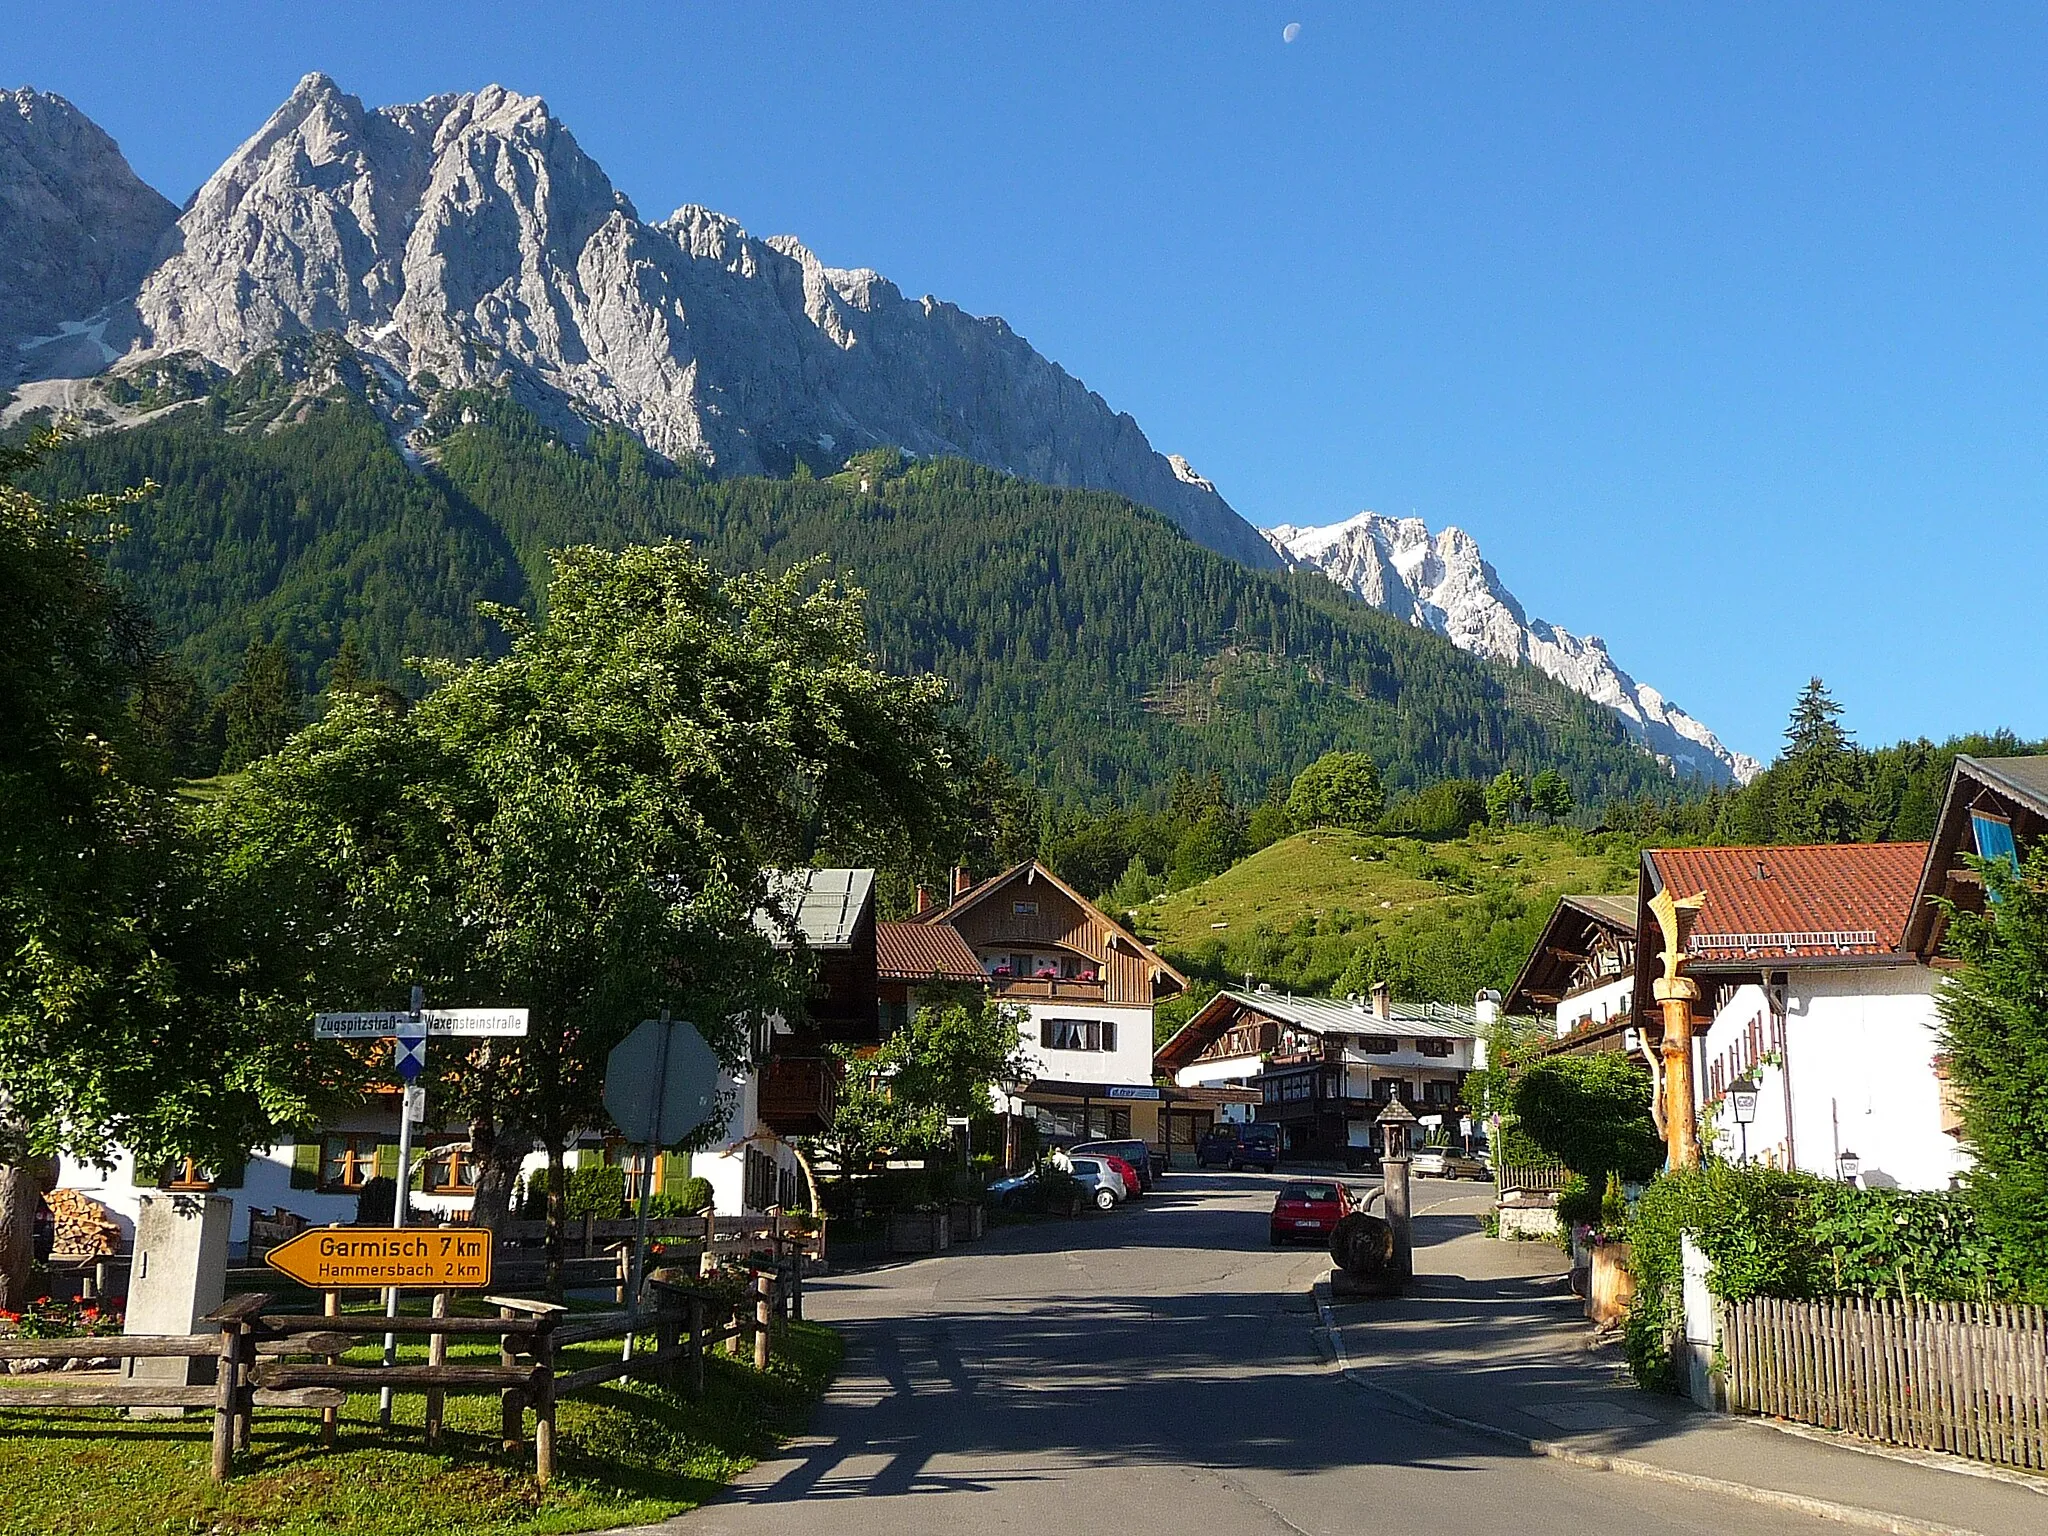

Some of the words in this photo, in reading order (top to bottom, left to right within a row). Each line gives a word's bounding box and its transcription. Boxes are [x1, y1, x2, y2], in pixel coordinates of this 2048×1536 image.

[424, 1014, 521, 1030] Waxensteinstraße
[320, 1237, 428, 1257] Garmisch
[439, 1237, 452, 1257] 7
[456, 1237, 481, 1257] km
[319, 1263, 434, 1277] Hammersbach
[445, 1263, 454, 1277] 2
[457, 1263, 481, 1277] km
